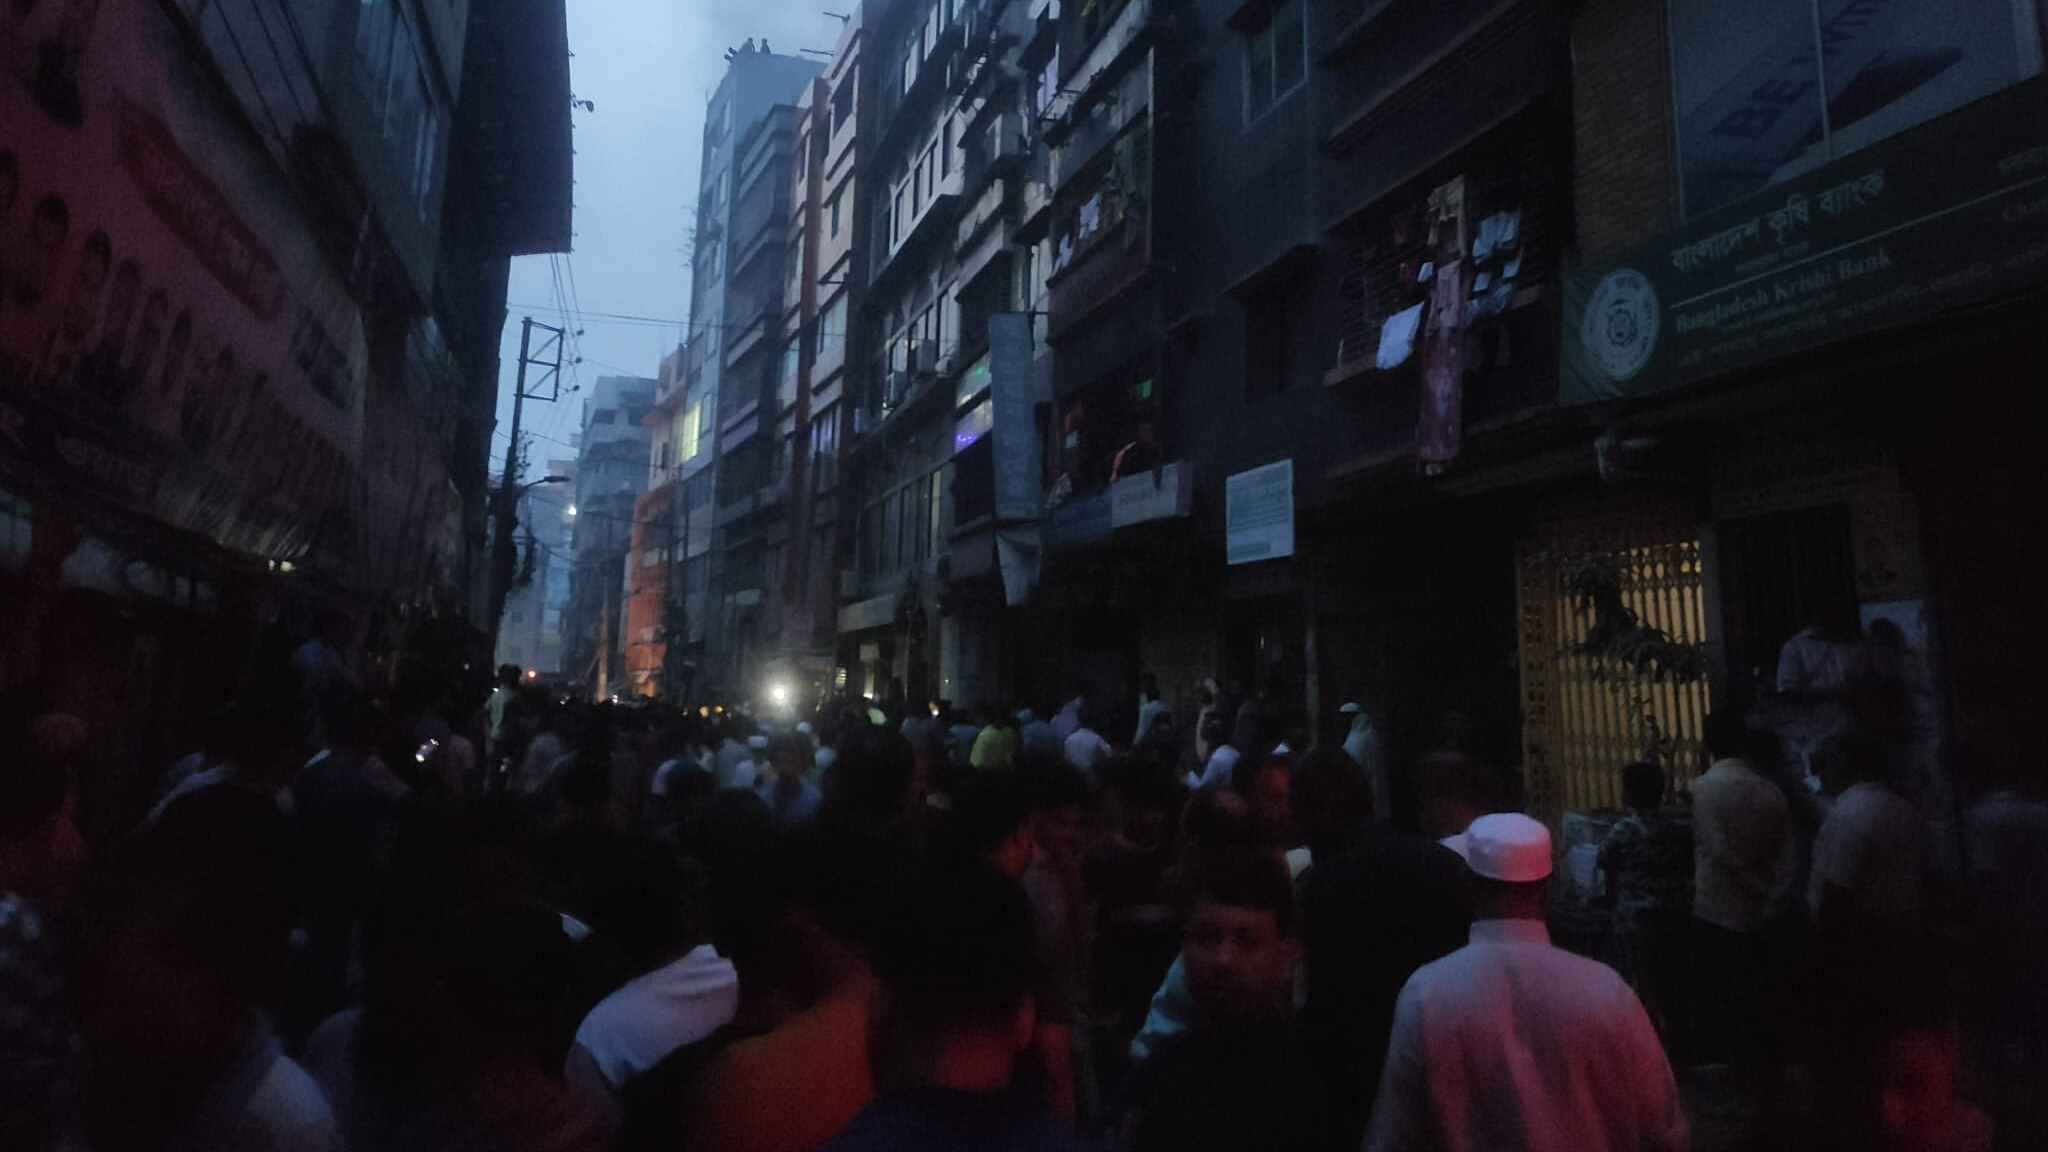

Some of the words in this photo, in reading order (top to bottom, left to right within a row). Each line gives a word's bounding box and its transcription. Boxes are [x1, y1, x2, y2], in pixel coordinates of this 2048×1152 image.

[1671, 219, 1760, 271] বাংলাদেশ
[1768, 195, 1808, 243] কৃষি
[1820, 170, 1885, 214] ব্যাংক
[1677, 289, 1768, 332] Bangladesh
[1775, 265, 1832, 304] Krishi
[1840, 247, 1891, 280] Bank
